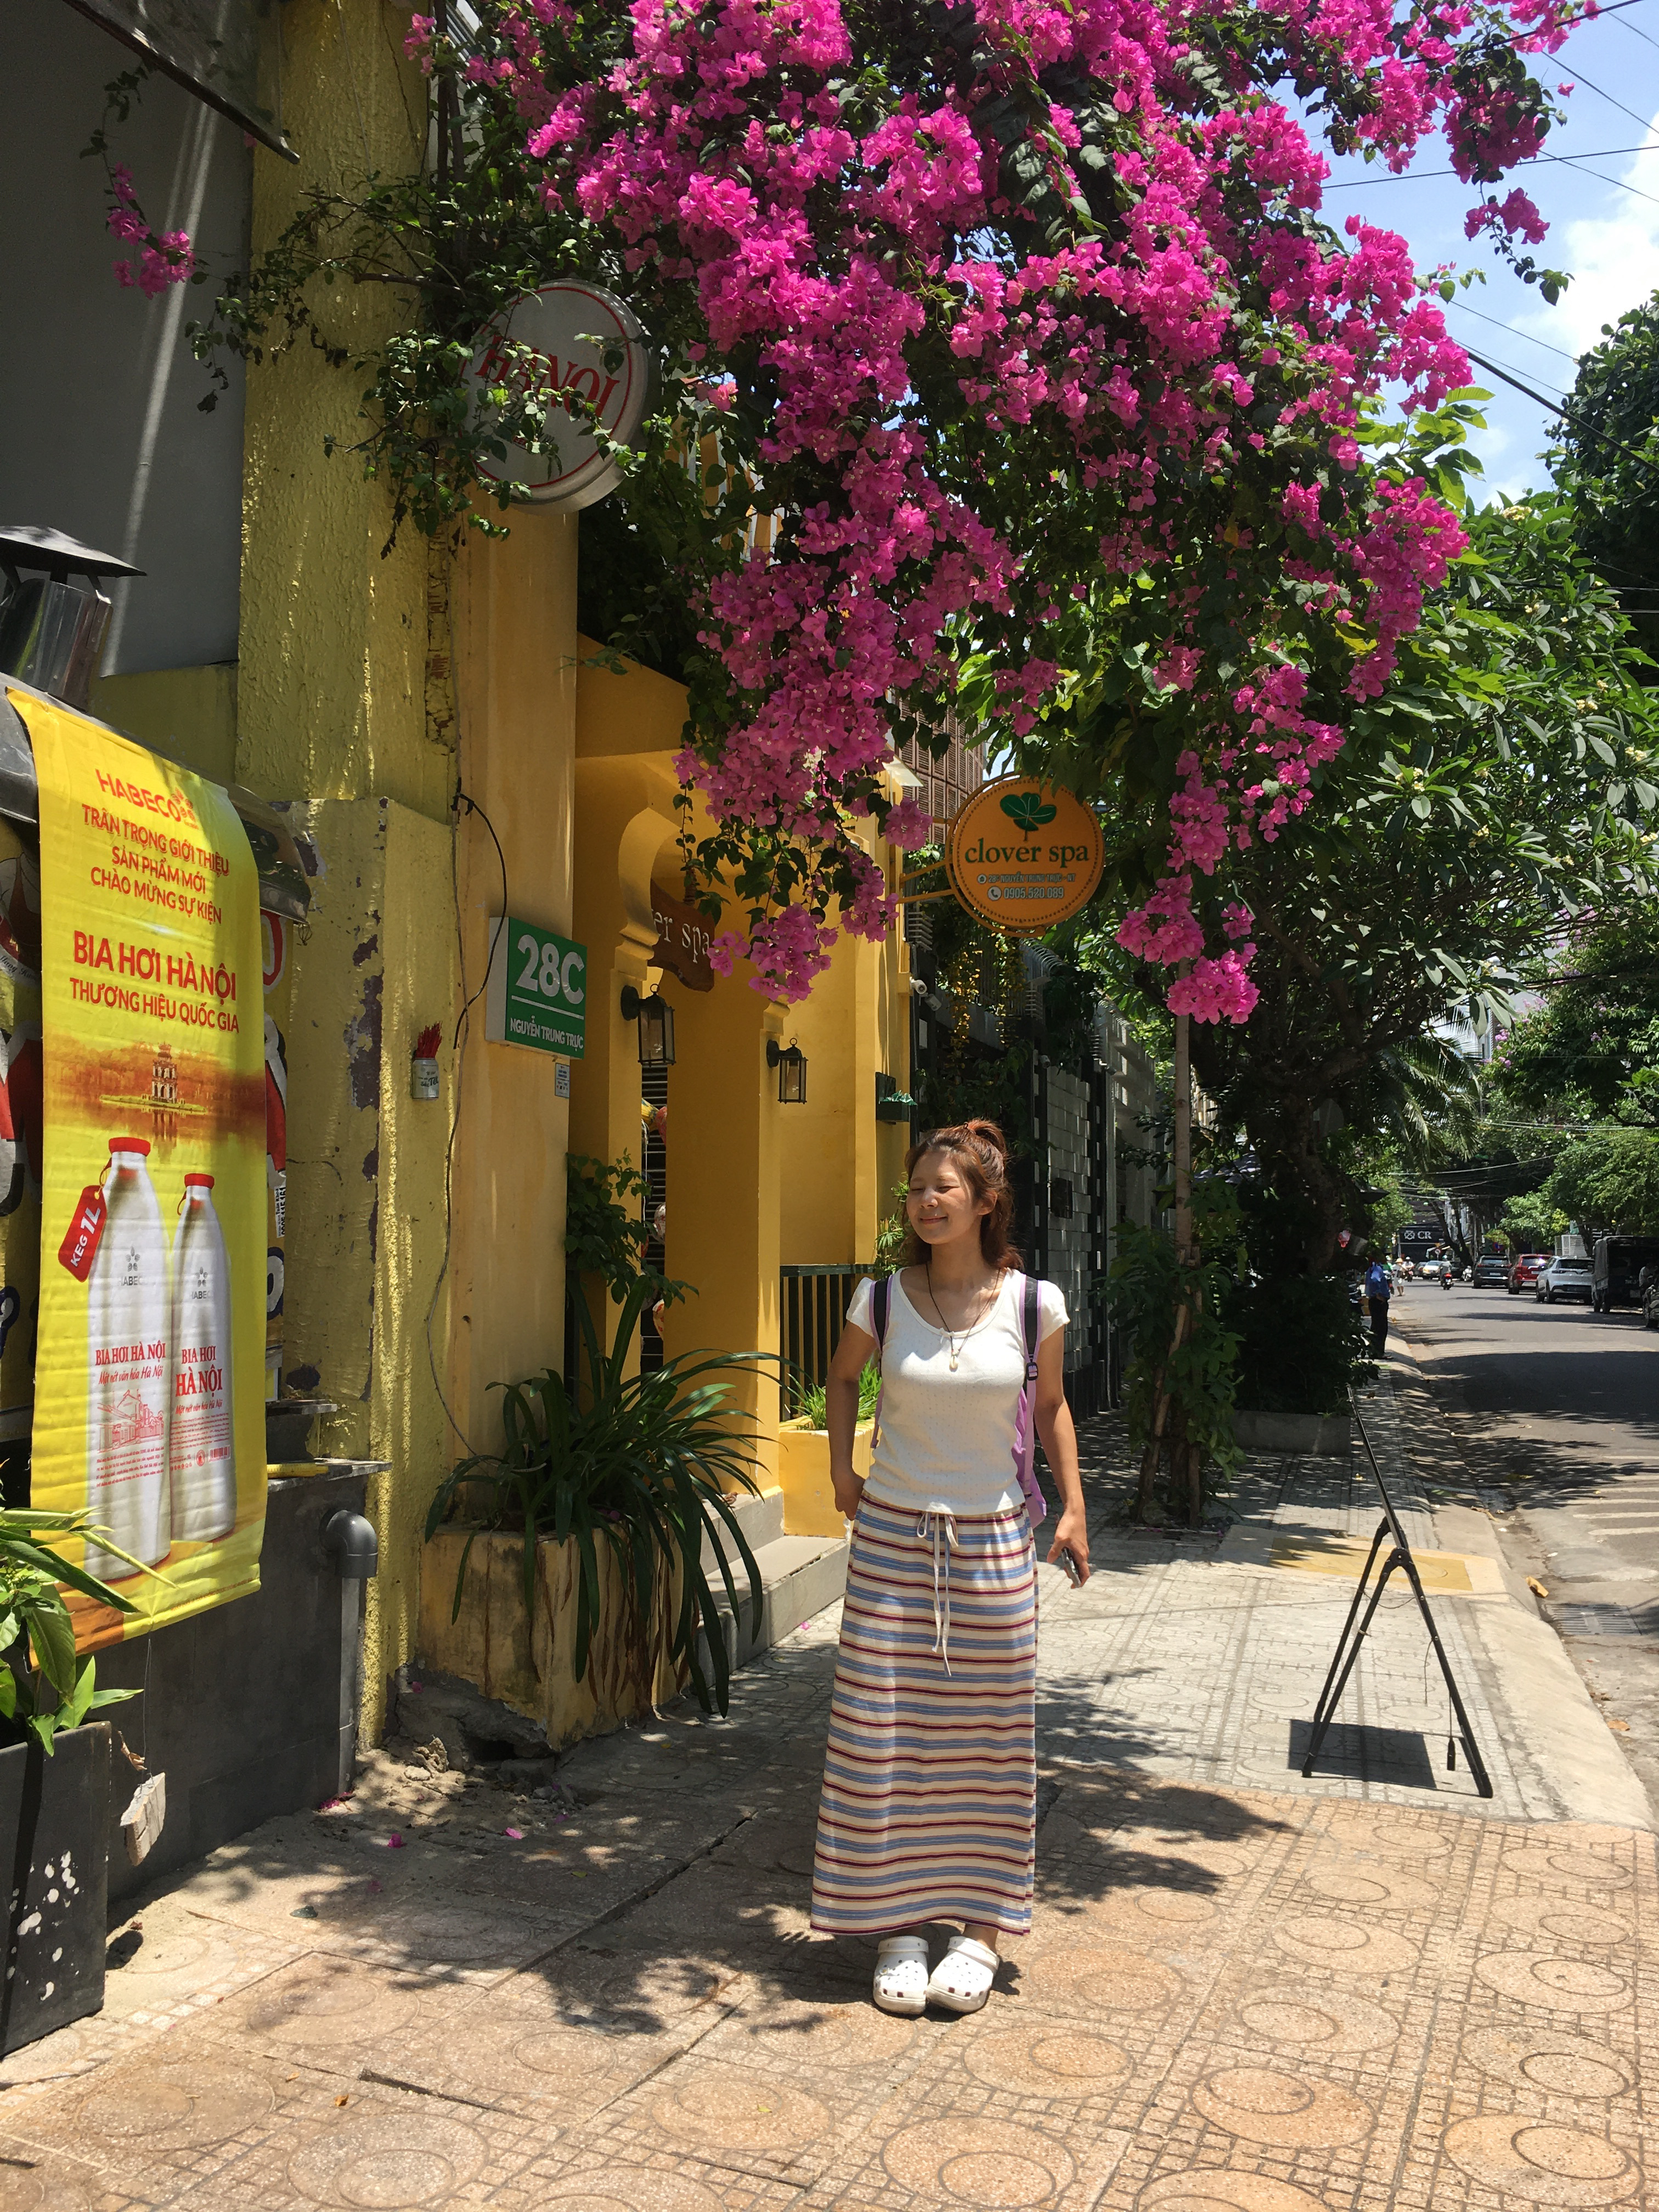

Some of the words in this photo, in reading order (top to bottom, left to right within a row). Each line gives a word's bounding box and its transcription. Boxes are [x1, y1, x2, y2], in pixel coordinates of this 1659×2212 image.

[95, 768, 182, 822] HABECO
[82, 803, 121, 836] TRÂN
[122, 819, 167, 854] TRỌNG
[169, 838, 195, 864] GIỚI
[196, 847, 229, 877] THIỆU
[964, 837, 1042, 864] clover
[1049, 844, 1089, 868] spa
[111, 845, 139, 871] SẢN
[142, 856, 179, 885] PHẨM
[182, 871, 206, 894] MỚI
[1025, 873, 1045, 883] TRUNG
[91, 866, 131, 895] CHÀO
[134, 879, 176, 910] MỪNG
[178, 894, 196, 918] SỰ
[197, 900, 222, 926] KIỆN
[1003, 887, 1064, 899] 0905.520.089
[682, 923, 710, 964] spa
[74, 930, 115, 972] BIA
[119, 942, 161, 983] HƠI
[167, 951, 198, 991] HÀ
[201, 963, 236, 1006] NỘI
[516, 934, 585, 1005] 28C
[70, 977, 140, 1012] THƯƠNG
[143, 994, 176, 1022] HIỆU
[179, 1002, 216, 1026] QUỐC
[217, 1012, 240, 1034] GIA
[541, 1025, 565, 1045] TRUNG
[566, 1032, 584, 1052] TRỰC
[70, 1234, 88, 1267] KEG
[80, 1207, 101, 1234] 1L
[1417, 1231, 1432, 1239] CR
[95, 1348, 111, 1365] BIA
[111, 1346, 129, 1363] HƠI
[130, 1341, 145, 1361] HÀ
[147, 1340, 166, 1363] NỘI
[181, 1348, 198, 1364] BIA
[199, 1345, 216, 1362] HƠI
[141, 1365, 151, 1379] Hà
[152, 1364, 163, 1379] Nội
[176, 1366, 198, 1397] HÀ
[198, 1364, 223, 1397] NỘI
